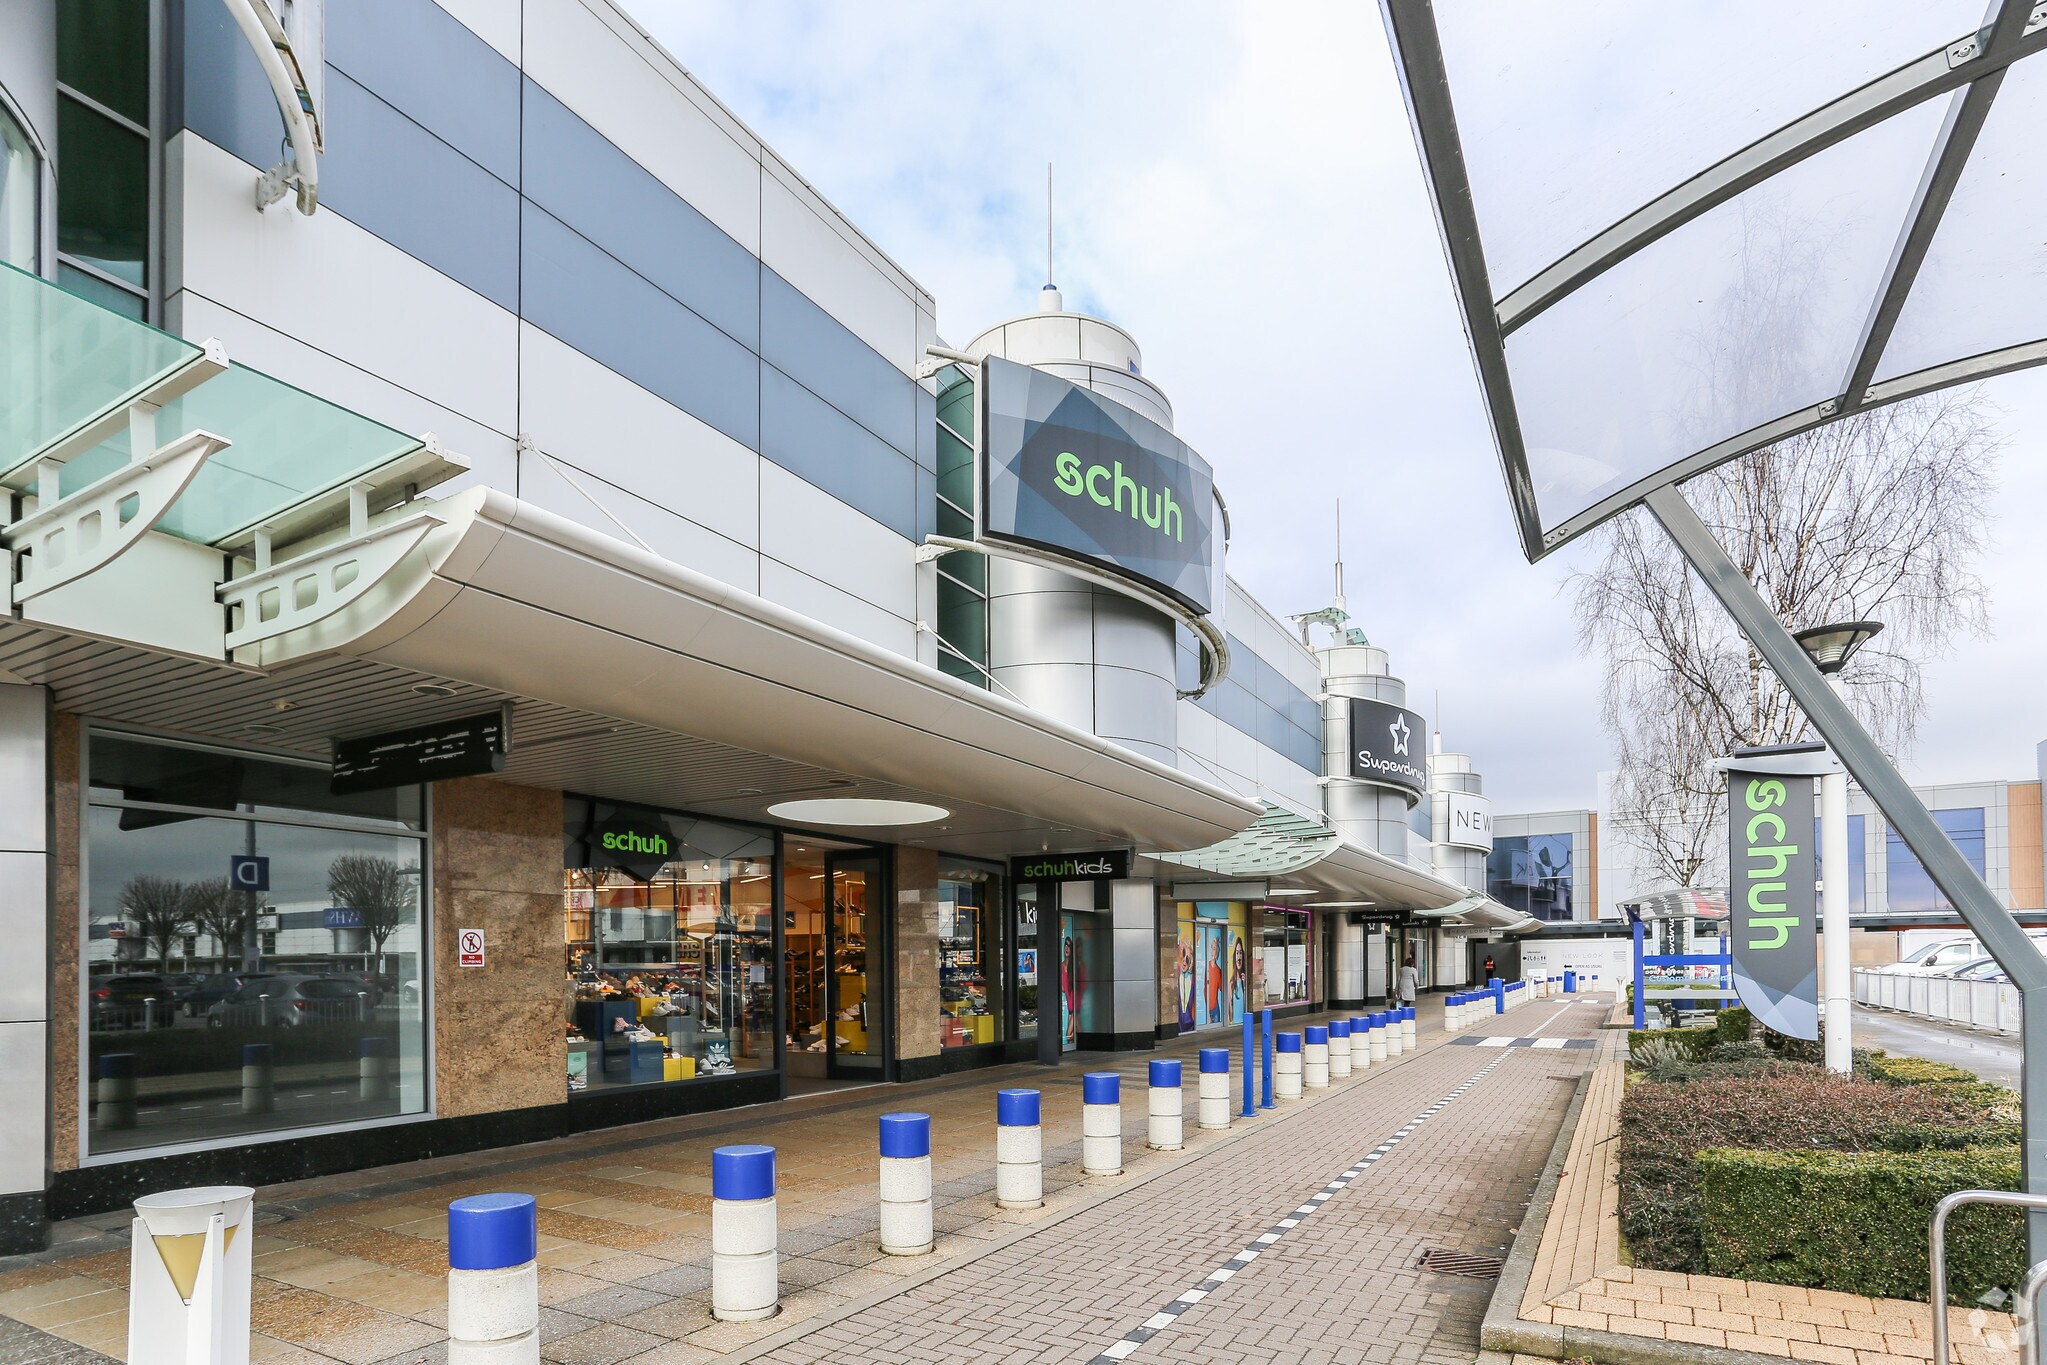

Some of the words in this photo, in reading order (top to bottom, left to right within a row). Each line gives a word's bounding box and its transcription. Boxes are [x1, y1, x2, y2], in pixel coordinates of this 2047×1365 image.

[1053, 451, 1183, 543] schuh
[1358, 750, 1426, 786] Superdrug
[1456, 810, 1492, 832] NEW
[602, 830, 668, 855] schuh
[1744, 778, 1800, 951] schuh
